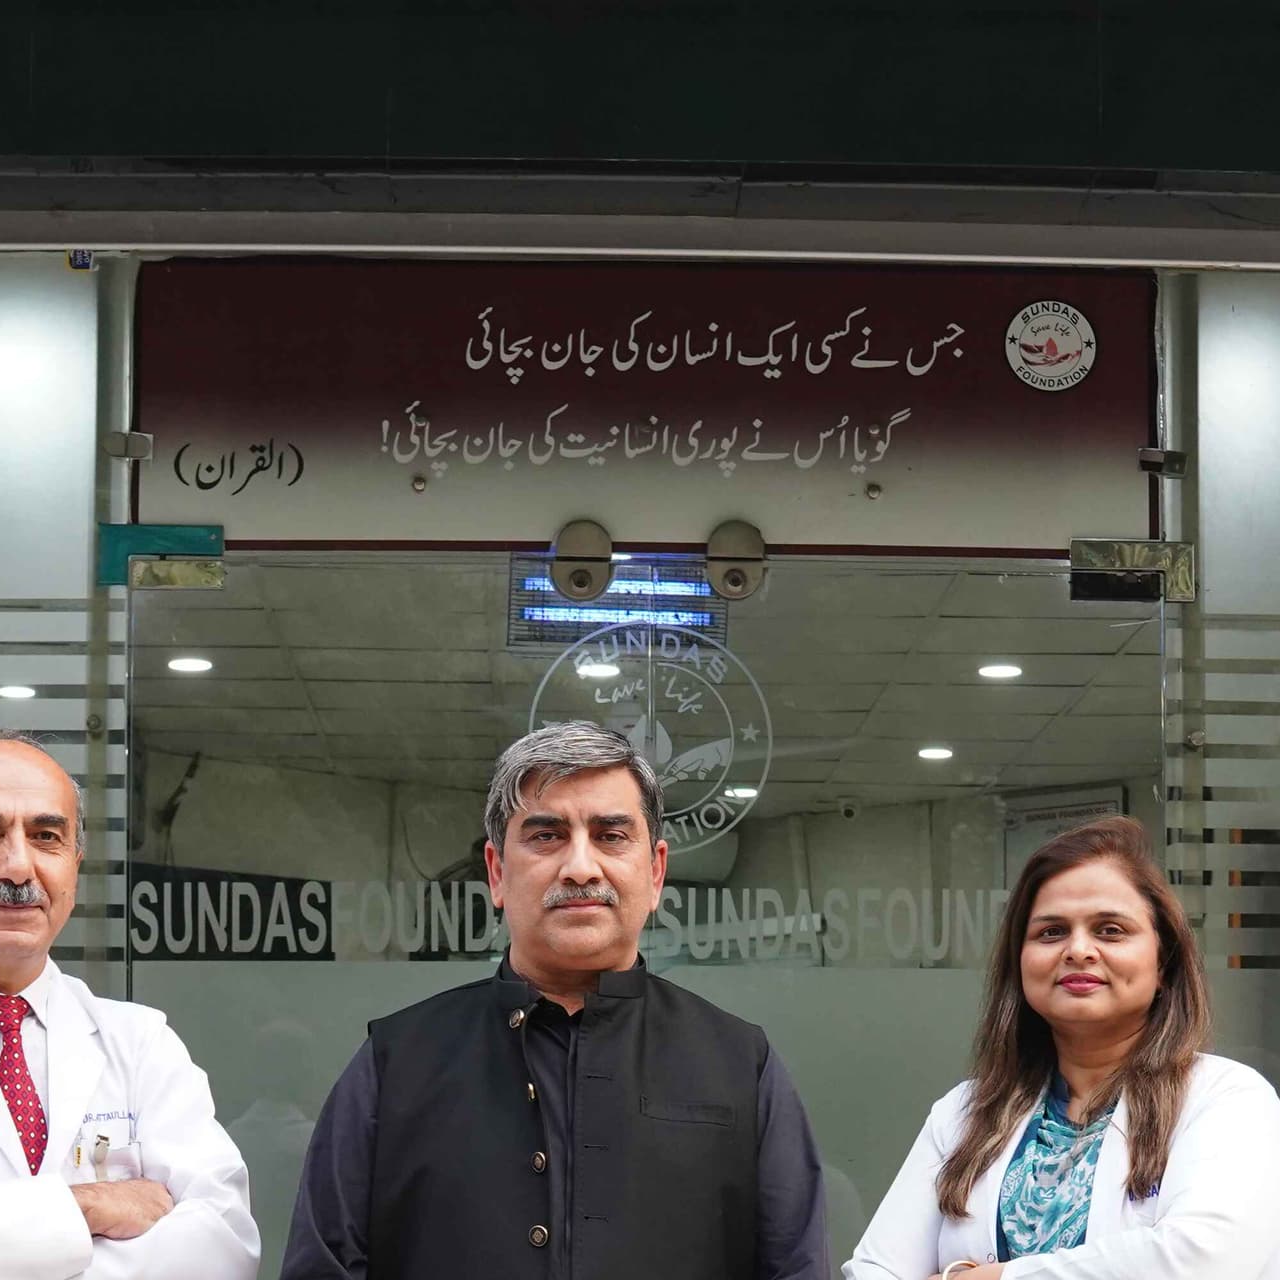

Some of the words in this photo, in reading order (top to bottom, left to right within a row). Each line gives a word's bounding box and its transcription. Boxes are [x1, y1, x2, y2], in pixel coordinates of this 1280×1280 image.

[805, 306, 868, 375] کسی
[1021, 302, 1080, 325] SUNDAS
[1054, 321, 1071, 337] Life
[465, 306, 534, 386] بچائی
[541, 328, 604, 378] جان
[612, 310, 653, 372] کی
[646, 322, 733, 372] انسان
[737, 320, 798, 380] ایک
[850, 326, 900, 369] نے
[906, 322, 966, 377] جس
[1016, 364, 1089, 388] FOUNDATION
[462, 421, 523, 472] جان
[528, 403, 569, 466] کی
[559, 414, 670, 466] انسانیت
[671, 419, 738, 478] پوری
[740, 418, 791, 461] نے
[850, 407, 912, 474] گویا
[573, 630, 729, 684] SUNDAS
[661, 785, 747, 844] ATION
